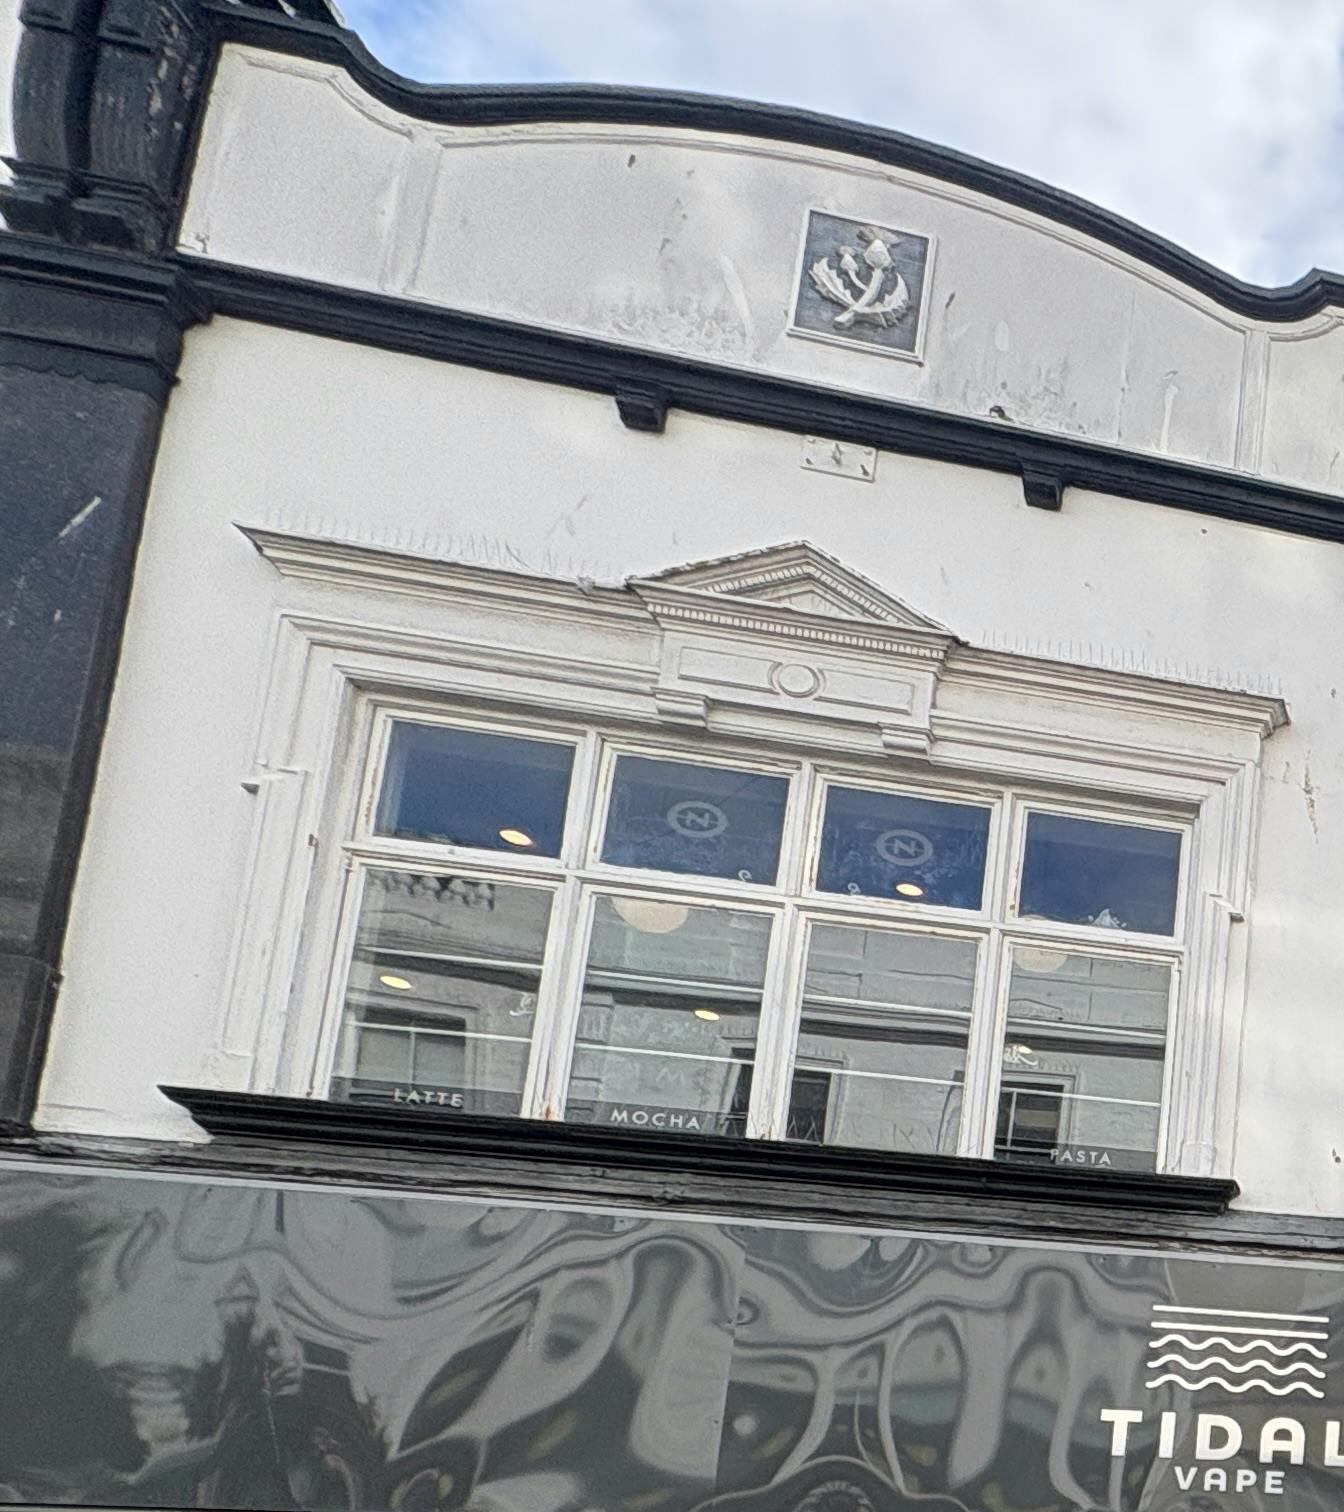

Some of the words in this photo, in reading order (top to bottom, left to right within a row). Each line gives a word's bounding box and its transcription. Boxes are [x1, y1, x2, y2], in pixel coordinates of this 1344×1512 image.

[392, 1087, 464, 1109] LATTE
[610, 1107, 701, 1130] MOCHA
[1049, 1148, 1112, 1166] PASTA
[1174, 1466, 1286, 1495] VAPE
